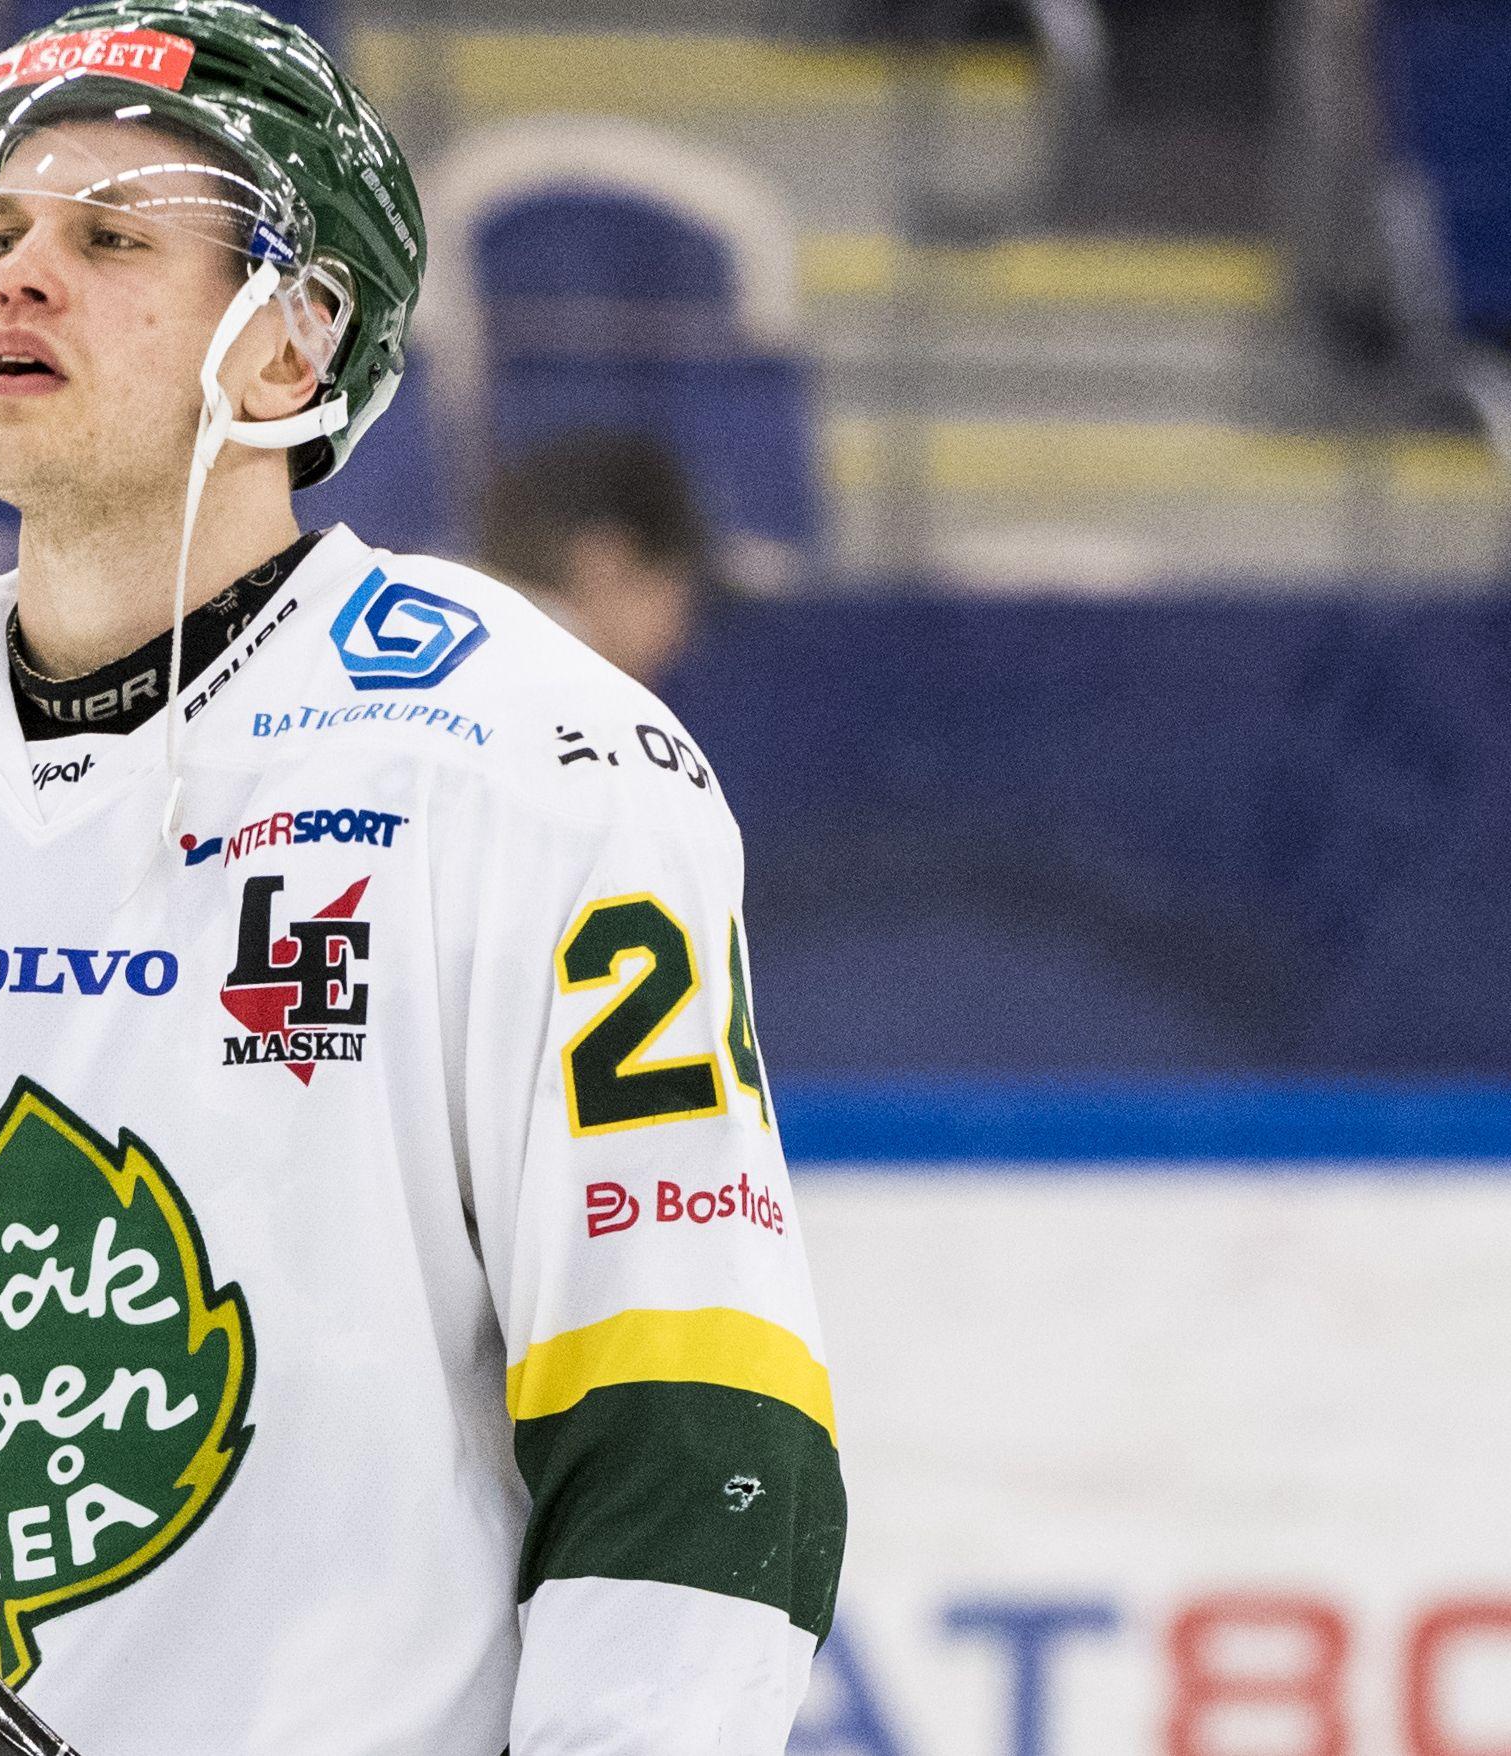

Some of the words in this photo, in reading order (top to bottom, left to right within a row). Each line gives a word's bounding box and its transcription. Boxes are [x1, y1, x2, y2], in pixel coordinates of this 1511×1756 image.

[38, 41, 168, 72] SOGETI
[225, 874, 371, 1026] LE
[222, 1031, 367, 1066] MASKIN
